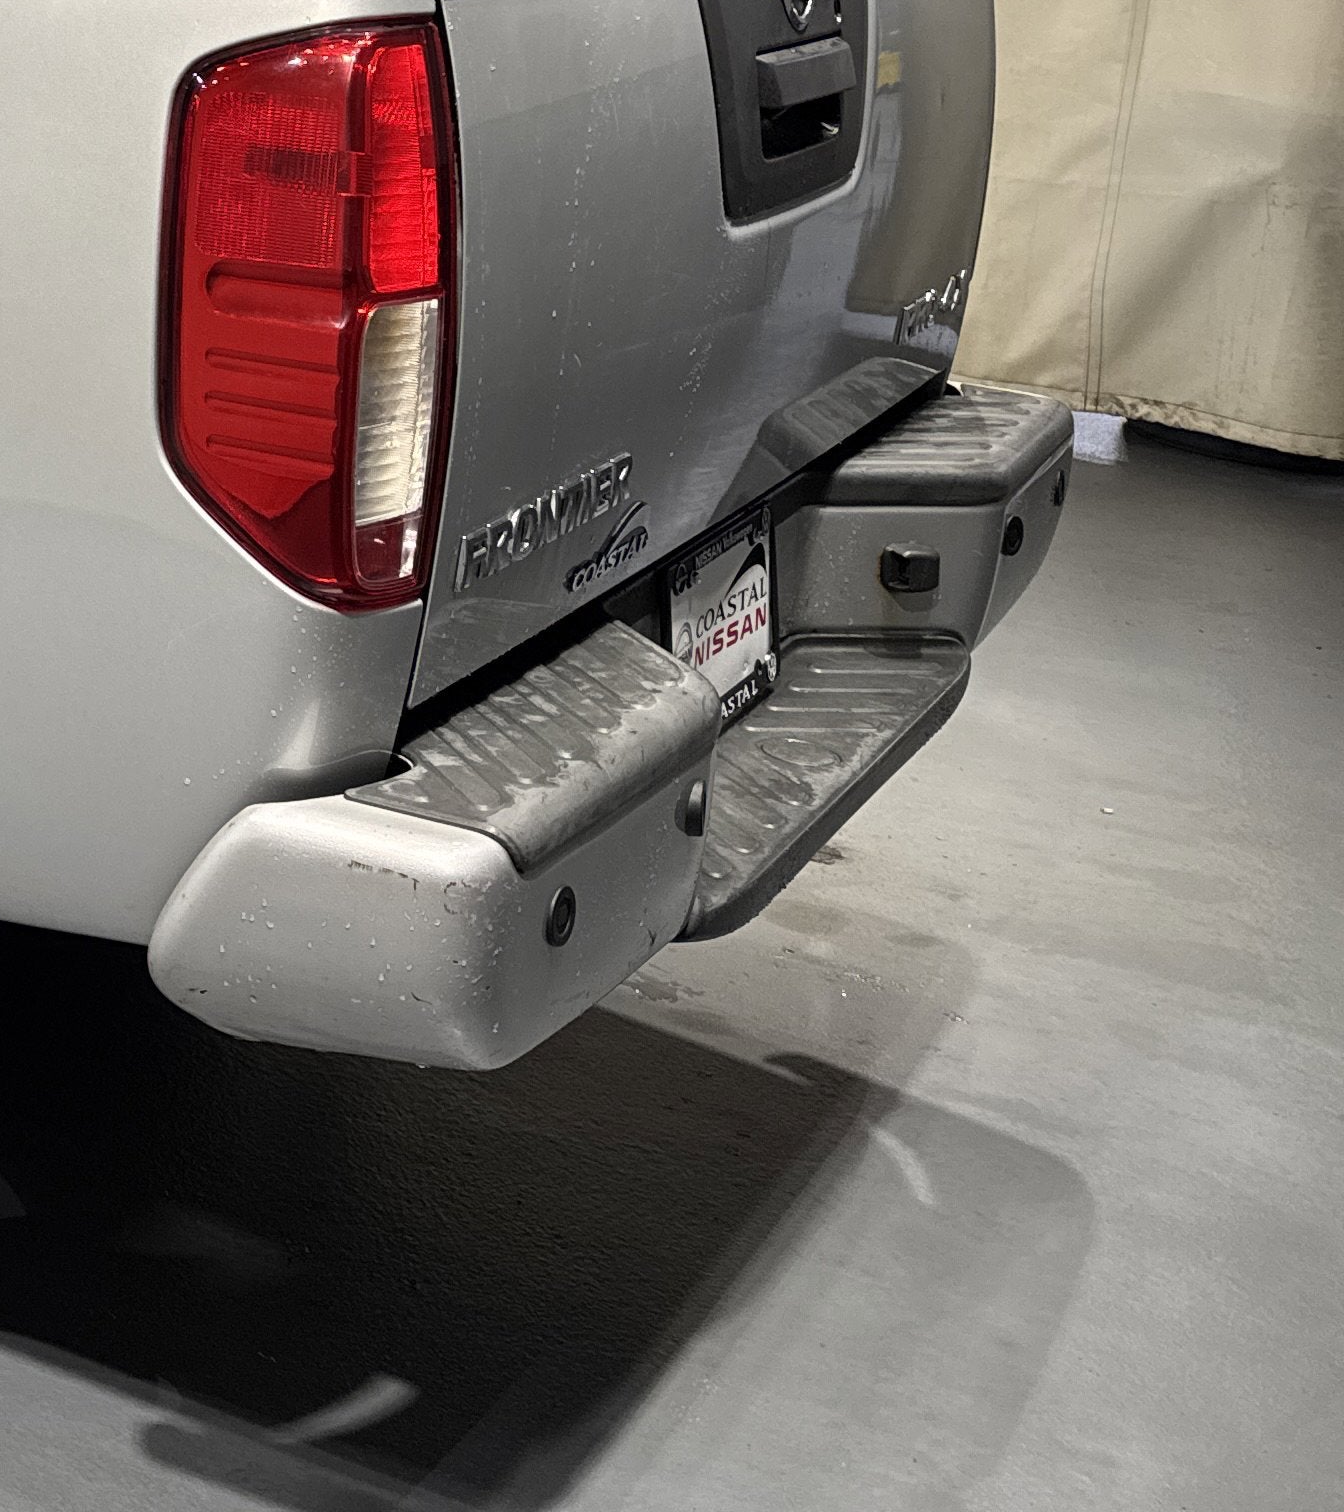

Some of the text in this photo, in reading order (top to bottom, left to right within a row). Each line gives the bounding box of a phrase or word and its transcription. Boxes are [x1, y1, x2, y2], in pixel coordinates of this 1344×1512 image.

[453, 451, 633, 593] FRONTIER
[569, 530, 649, 593] COASTAL
[694, 602, 767, 669] NISSAN
[695, 576, 768, 639] COASTAL
[720, 679, 759, 720] ASTAL
